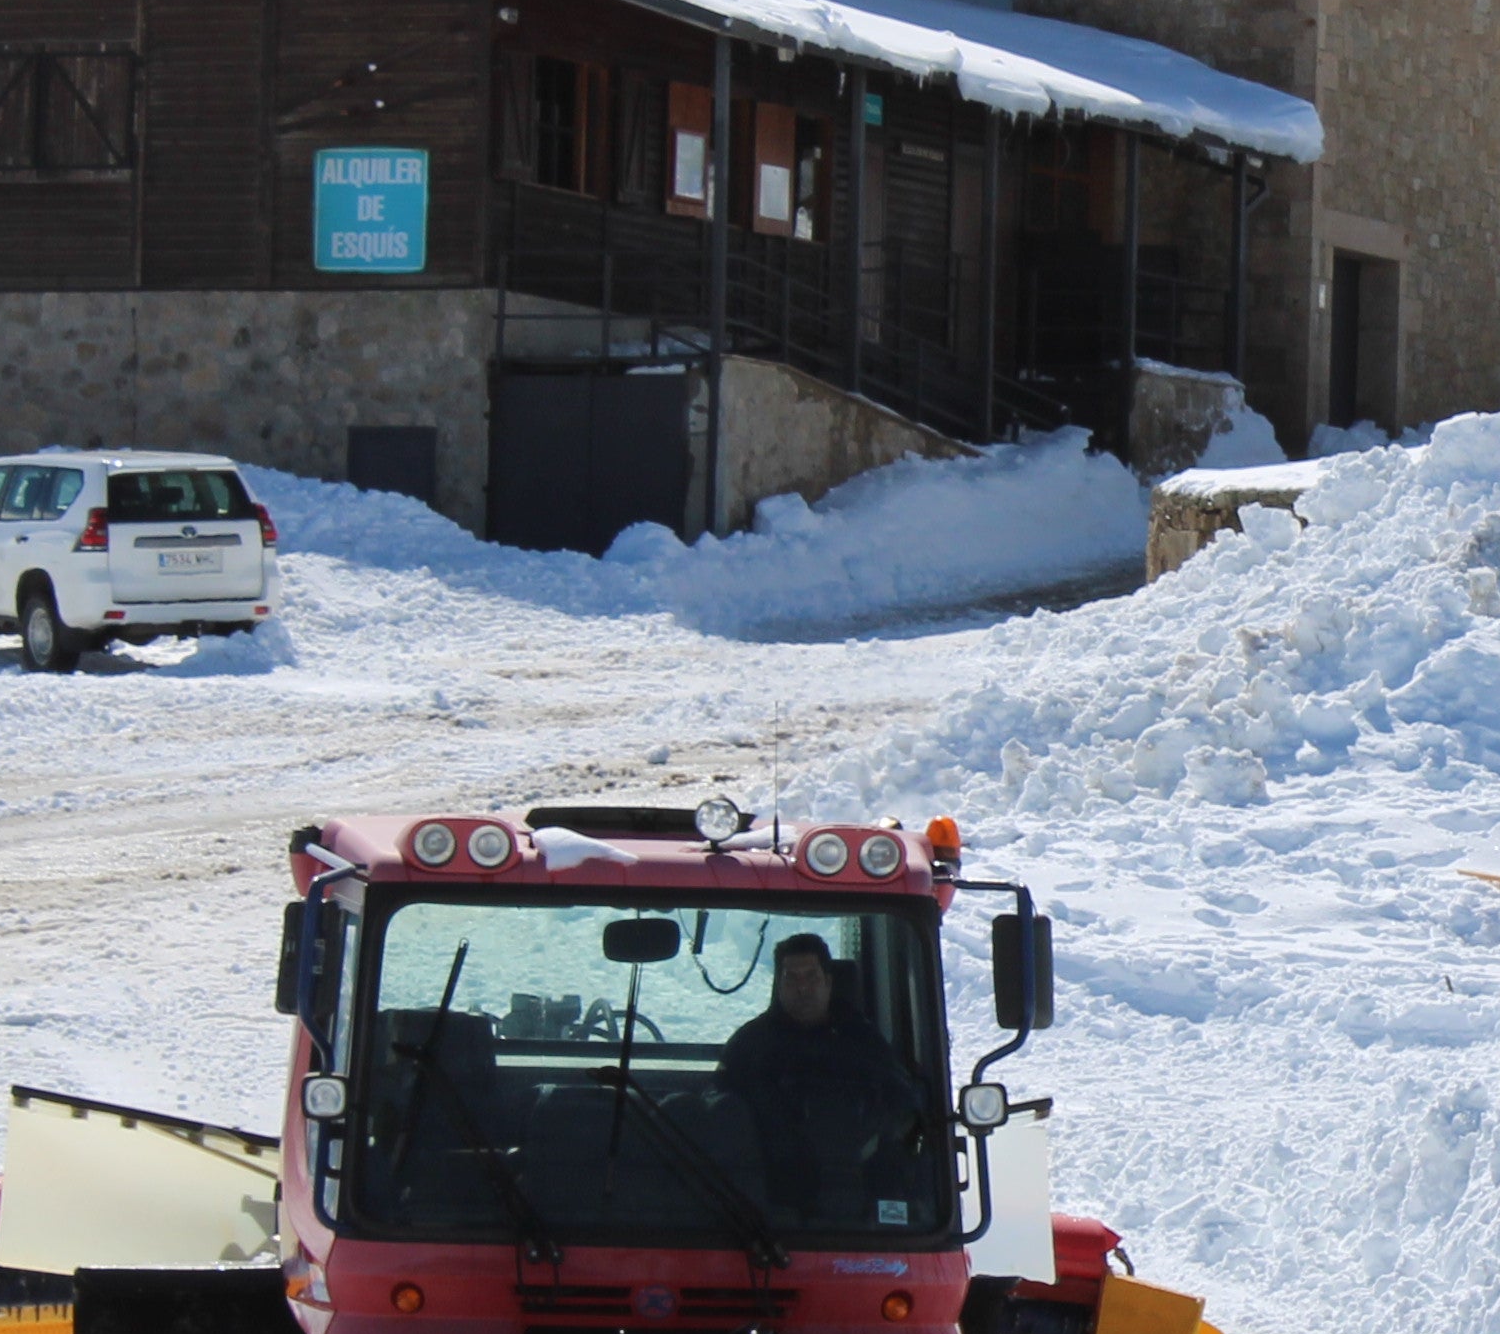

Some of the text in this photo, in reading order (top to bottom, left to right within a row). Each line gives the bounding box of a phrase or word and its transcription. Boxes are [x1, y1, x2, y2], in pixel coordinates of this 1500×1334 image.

[321, 157, 422, 188] ALQUILER
[357, 195, 385, 221] DE
[331, 226, 409, 262] ESQUÍS
